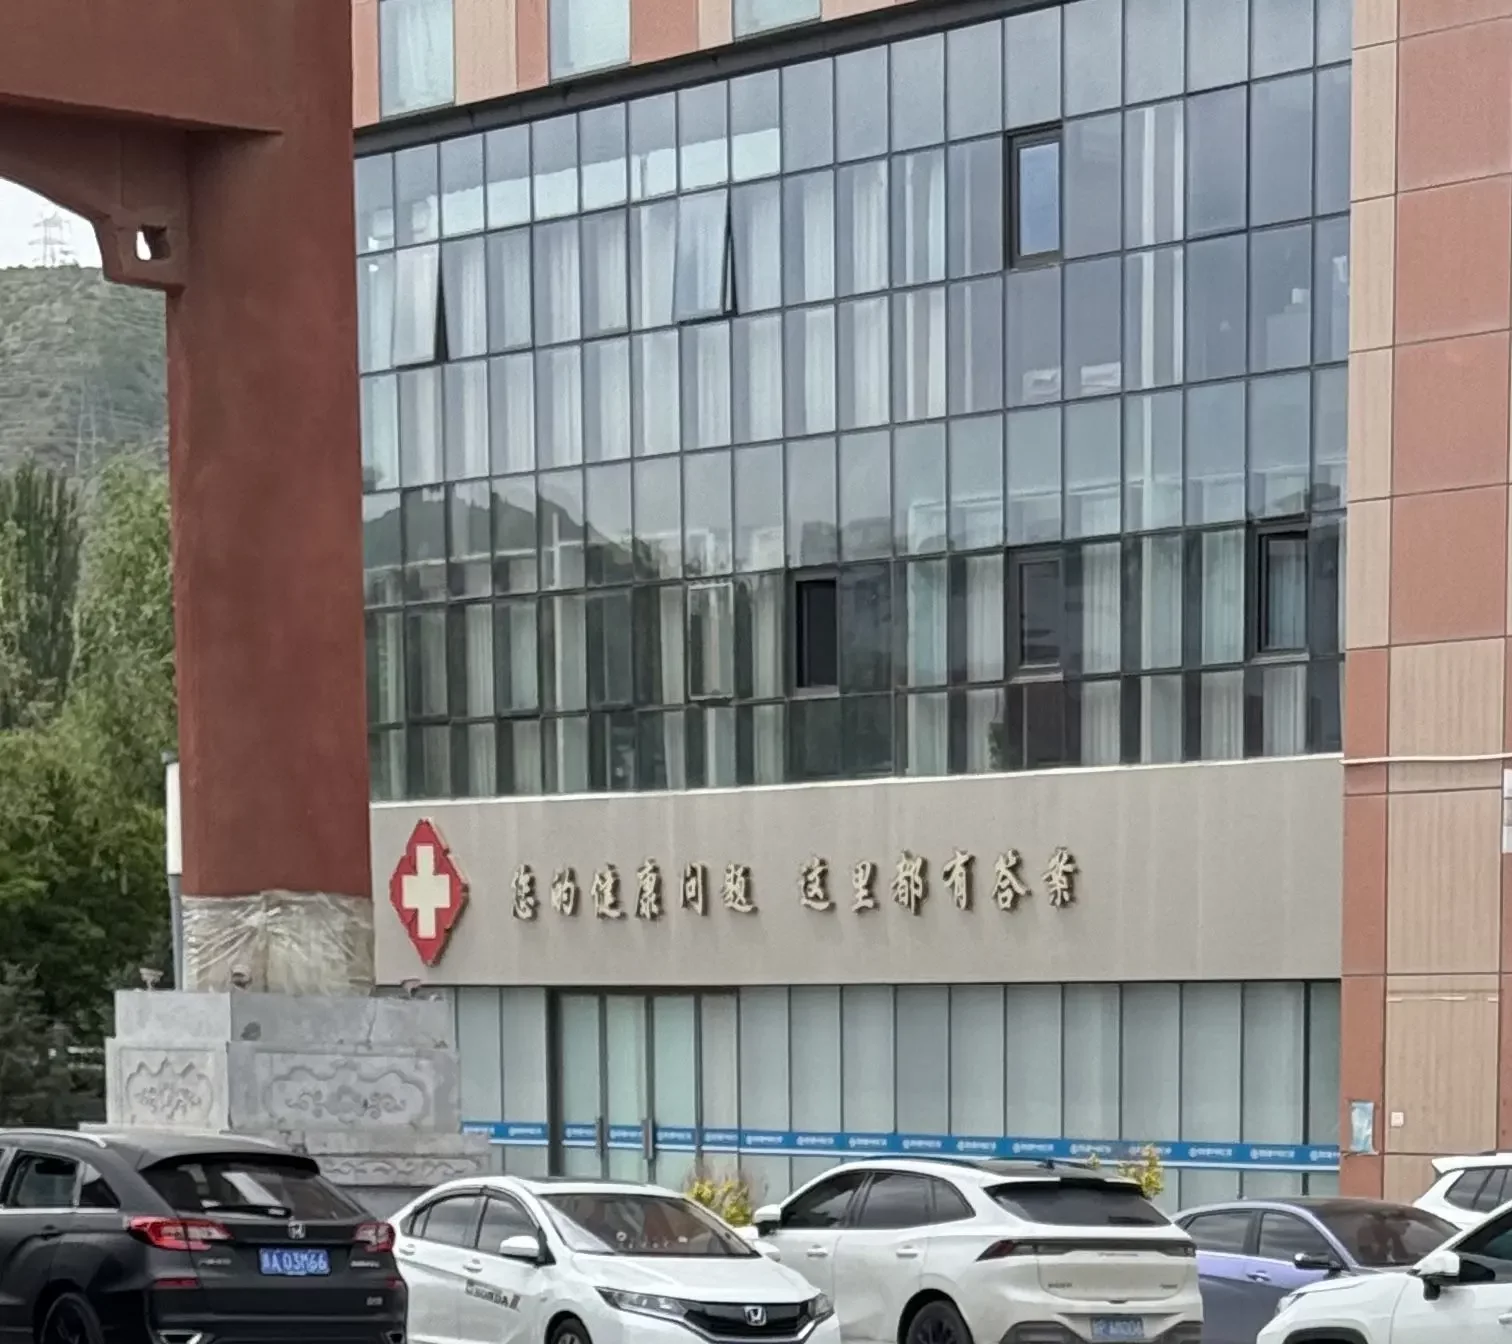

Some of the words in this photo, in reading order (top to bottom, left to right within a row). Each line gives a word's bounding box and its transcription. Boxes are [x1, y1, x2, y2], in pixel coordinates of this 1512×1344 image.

[511, 857, 757, 921] 您的健康问题
[797, 846, 1080, 916] 这里都有答案
